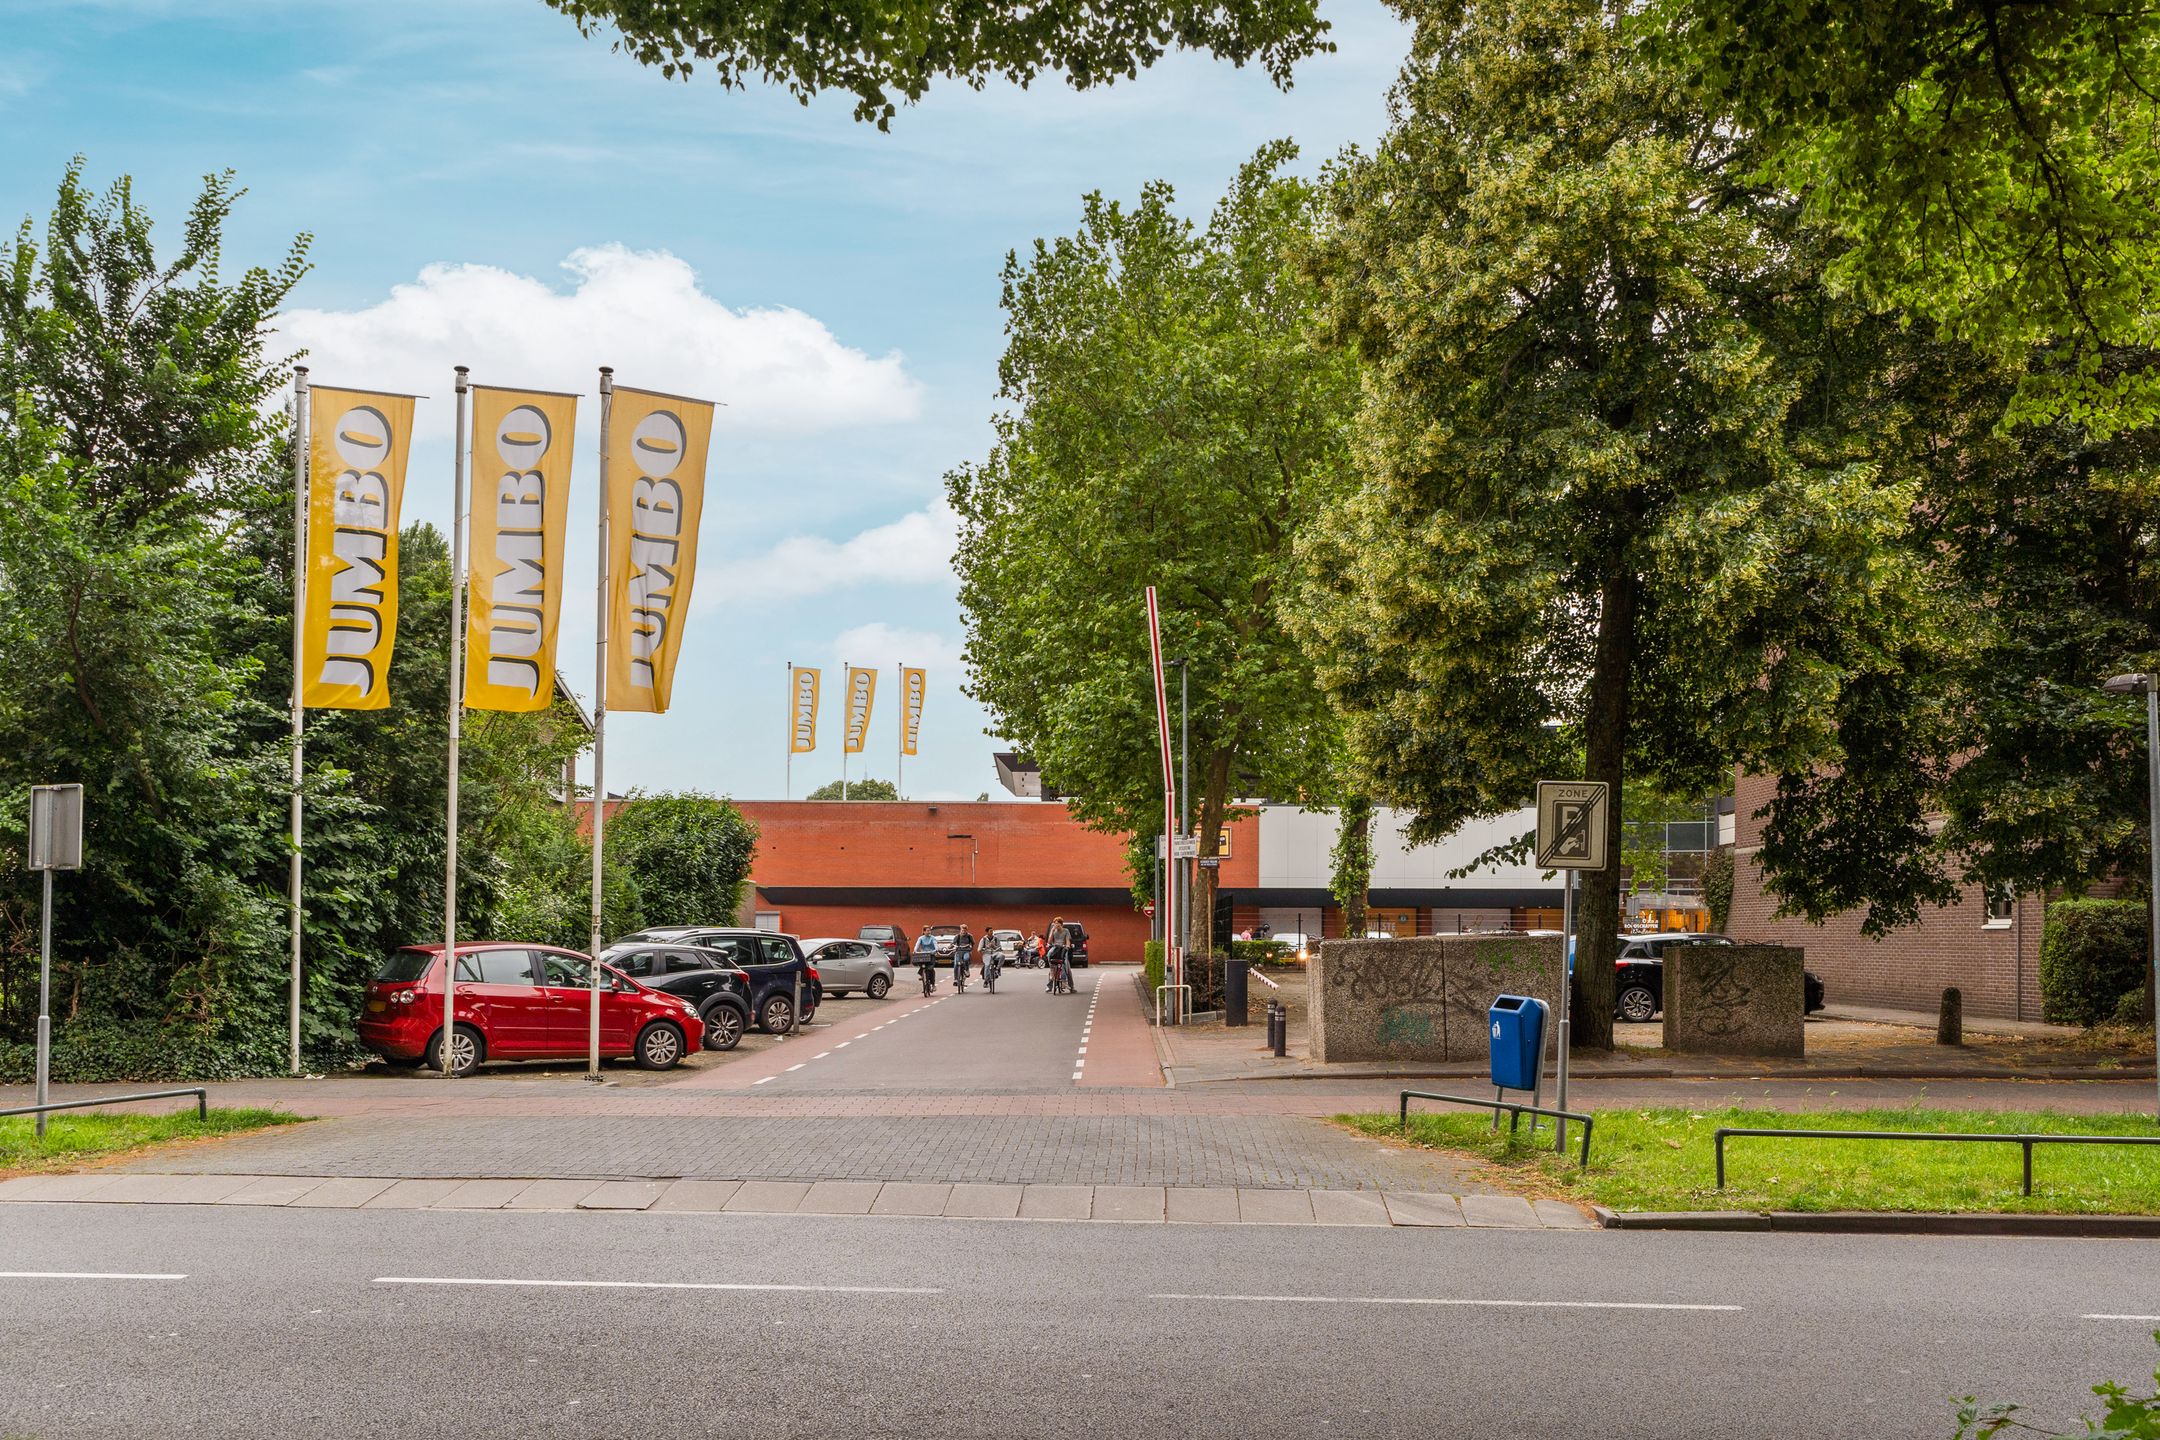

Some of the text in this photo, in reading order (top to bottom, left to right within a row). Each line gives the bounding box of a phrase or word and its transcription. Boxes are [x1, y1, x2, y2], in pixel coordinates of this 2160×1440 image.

[319, 405, 392, 698] JUMBO
[487, 404, 552, 700] JUMBO
[629, 409, 687, 689] JUMBO
[796, 672, 815, 748] JUMBO
[847, 672, 871, 750] JUMBO
[1558, 789, 1589, 798] ZONE
